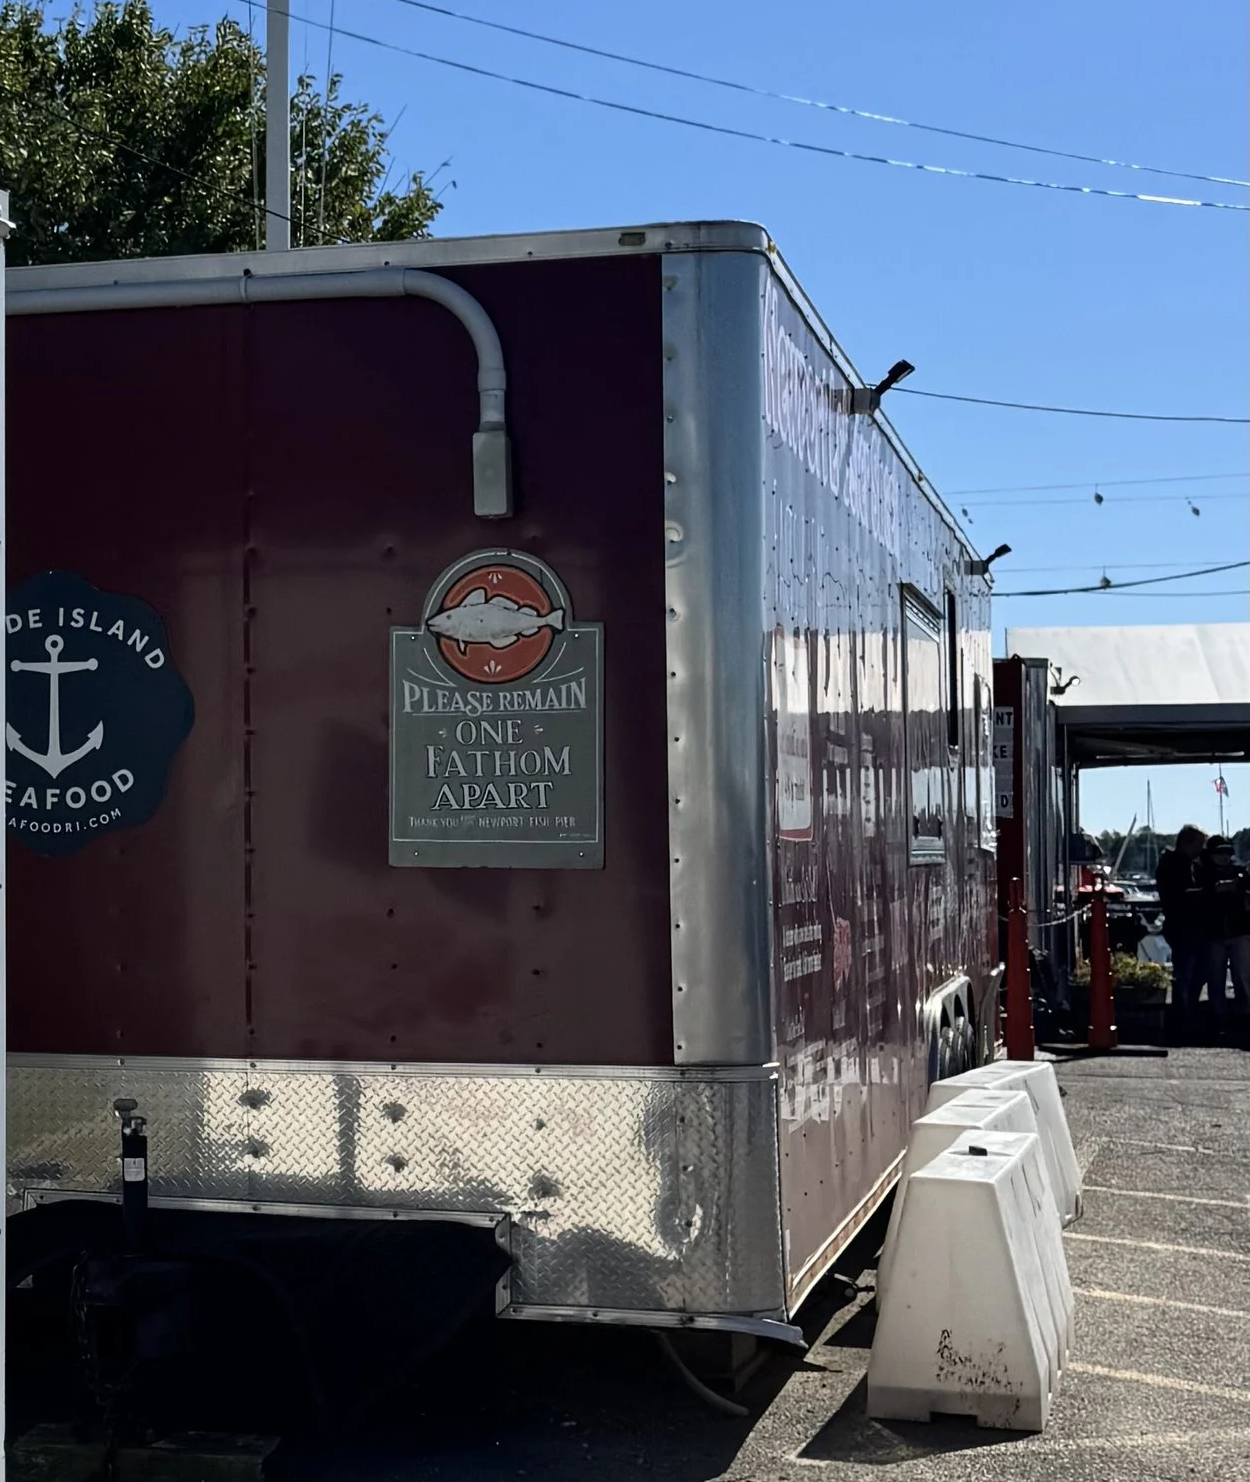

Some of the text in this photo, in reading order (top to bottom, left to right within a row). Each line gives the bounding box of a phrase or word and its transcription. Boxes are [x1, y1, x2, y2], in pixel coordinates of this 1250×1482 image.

[6, 607, 165, 669] DE ISLAND
[402, 677, 587, 717] PLEASE REMAIN
[455, 719, 524, 745] ONE
[426, 745, 572, 778] FATHOM
[430, 781, 554, 810] APART
[408, 816, 438, 828] THANK
[439, 816, 459, 828] YOU
[478, 816, 524, 828] NEWPORT
[555, 816, 577, 828] PIER
